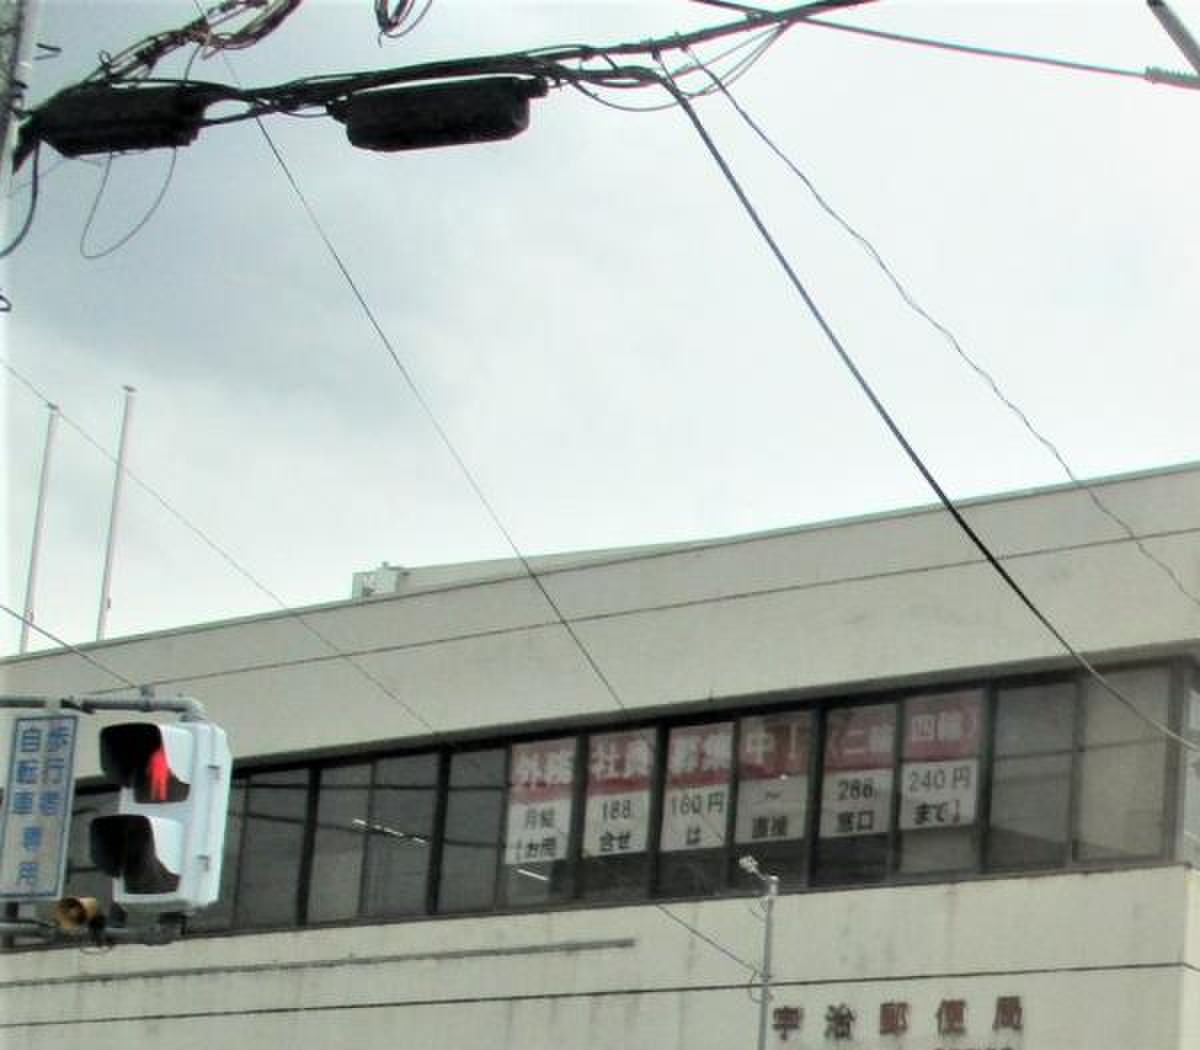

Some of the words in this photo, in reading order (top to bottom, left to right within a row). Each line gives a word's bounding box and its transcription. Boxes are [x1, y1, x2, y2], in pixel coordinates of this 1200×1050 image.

[773, 995, 1023, 1041] 宇治郵便局
